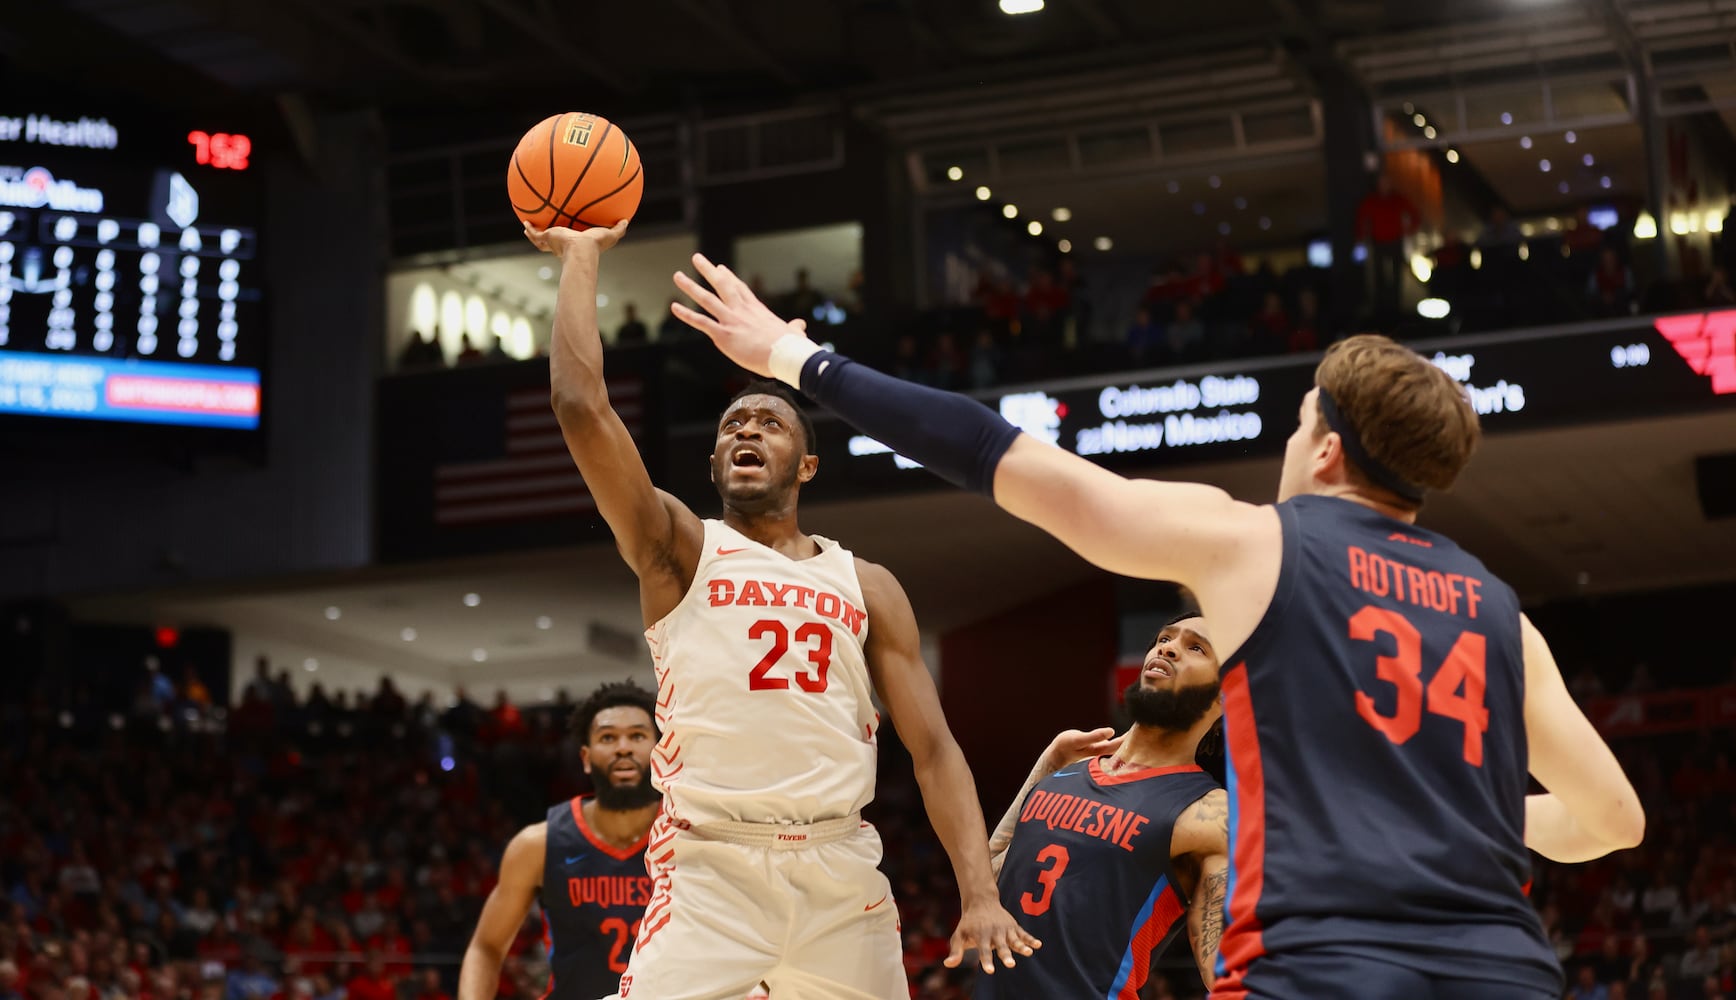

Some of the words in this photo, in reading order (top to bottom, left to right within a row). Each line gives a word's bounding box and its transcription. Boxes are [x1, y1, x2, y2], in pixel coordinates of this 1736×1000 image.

[26, 113, 118, 149] Health
[1099, 379, 1201, 419] Colorado
[1200, 374, 1260, 408] State
[1101, 420, 1164, 455] New
[1164, 409, 1262, 447] Mexico
[707, 579, 867, 637] DAYTON
[1348, 545, 1483, 619] ROTROFF
[748, 619, 833, 693] 23
[1349, 604, 1489, 768] 34
[777, 833, 807, 842] FLYERS
[1020, 790, 1150, 853] DUQUESNE
[567, 875, 652, 909] DUQUES
[1020, 843, 1070, 917] 3
